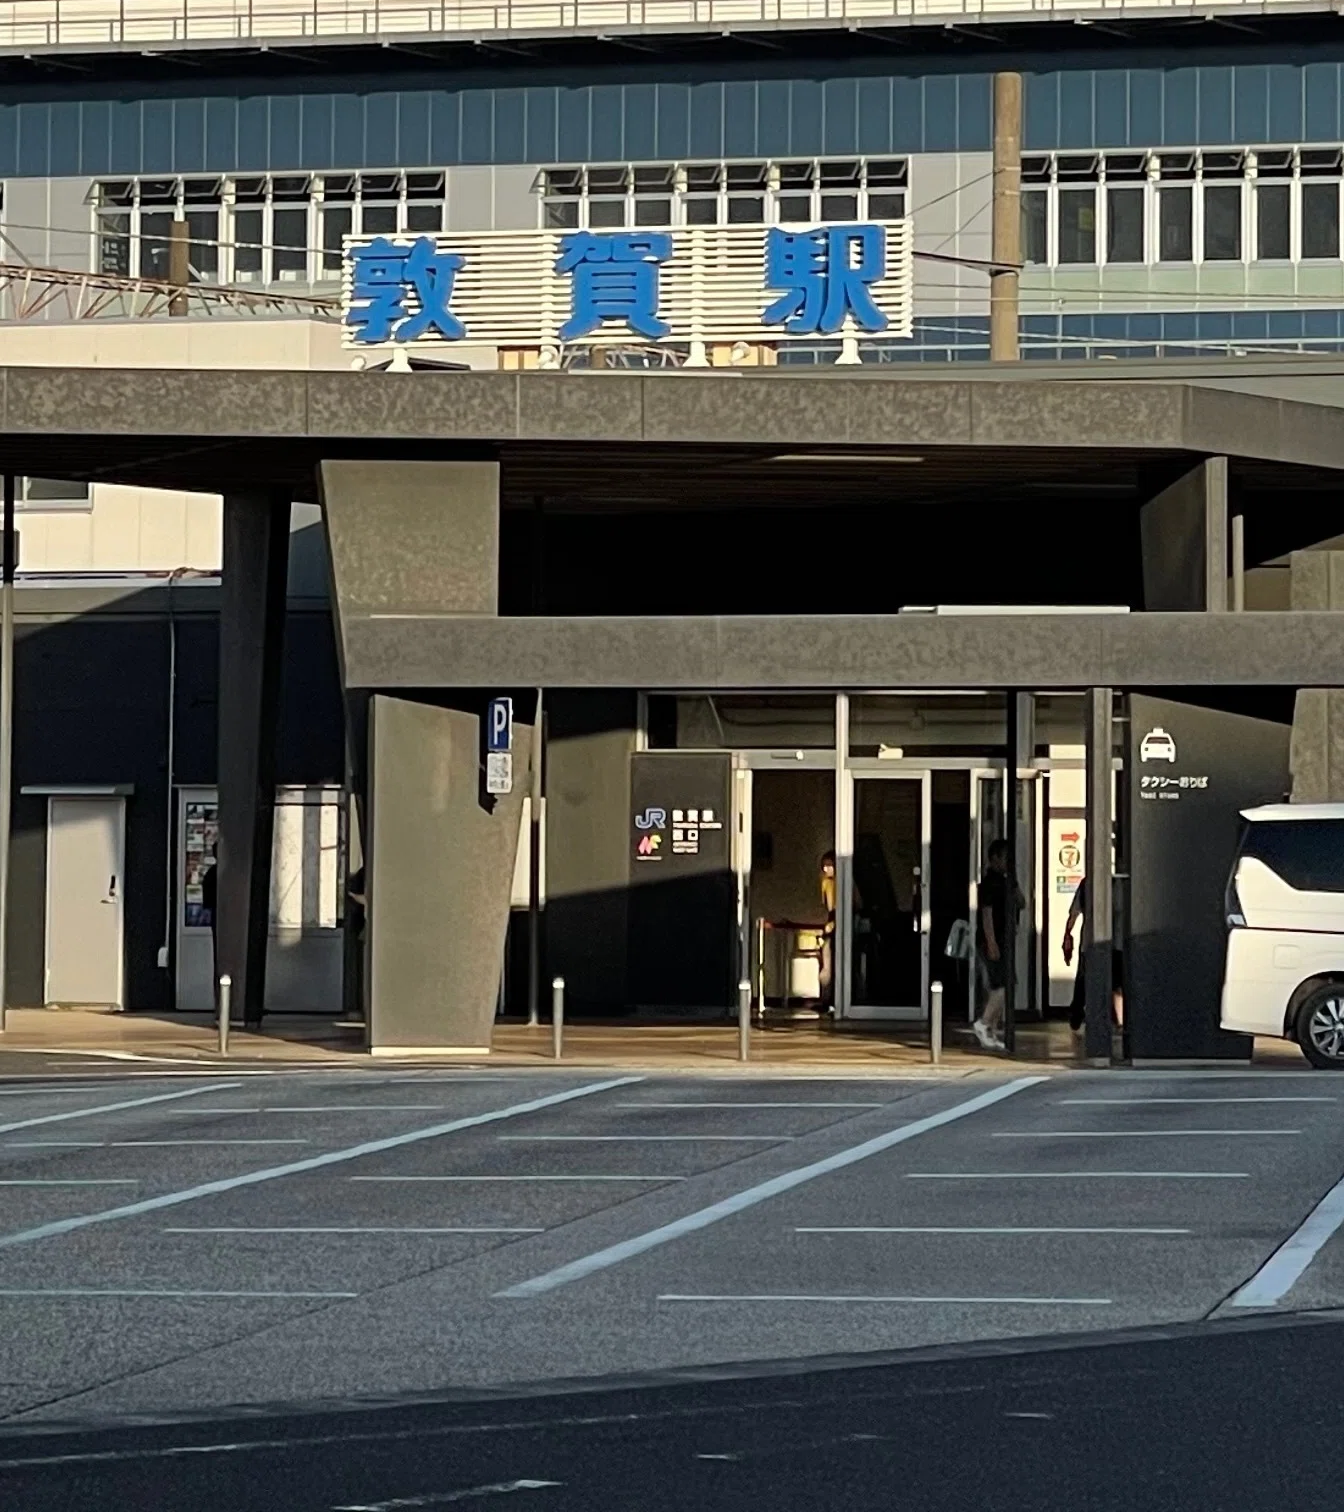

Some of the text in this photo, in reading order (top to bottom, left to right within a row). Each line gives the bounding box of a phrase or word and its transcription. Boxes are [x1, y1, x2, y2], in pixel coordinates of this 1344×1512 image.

[346, 225, 888, 342] 敦賀駅
[493, 703, 507, 746] P
[635, 808, 666, 828] JR
